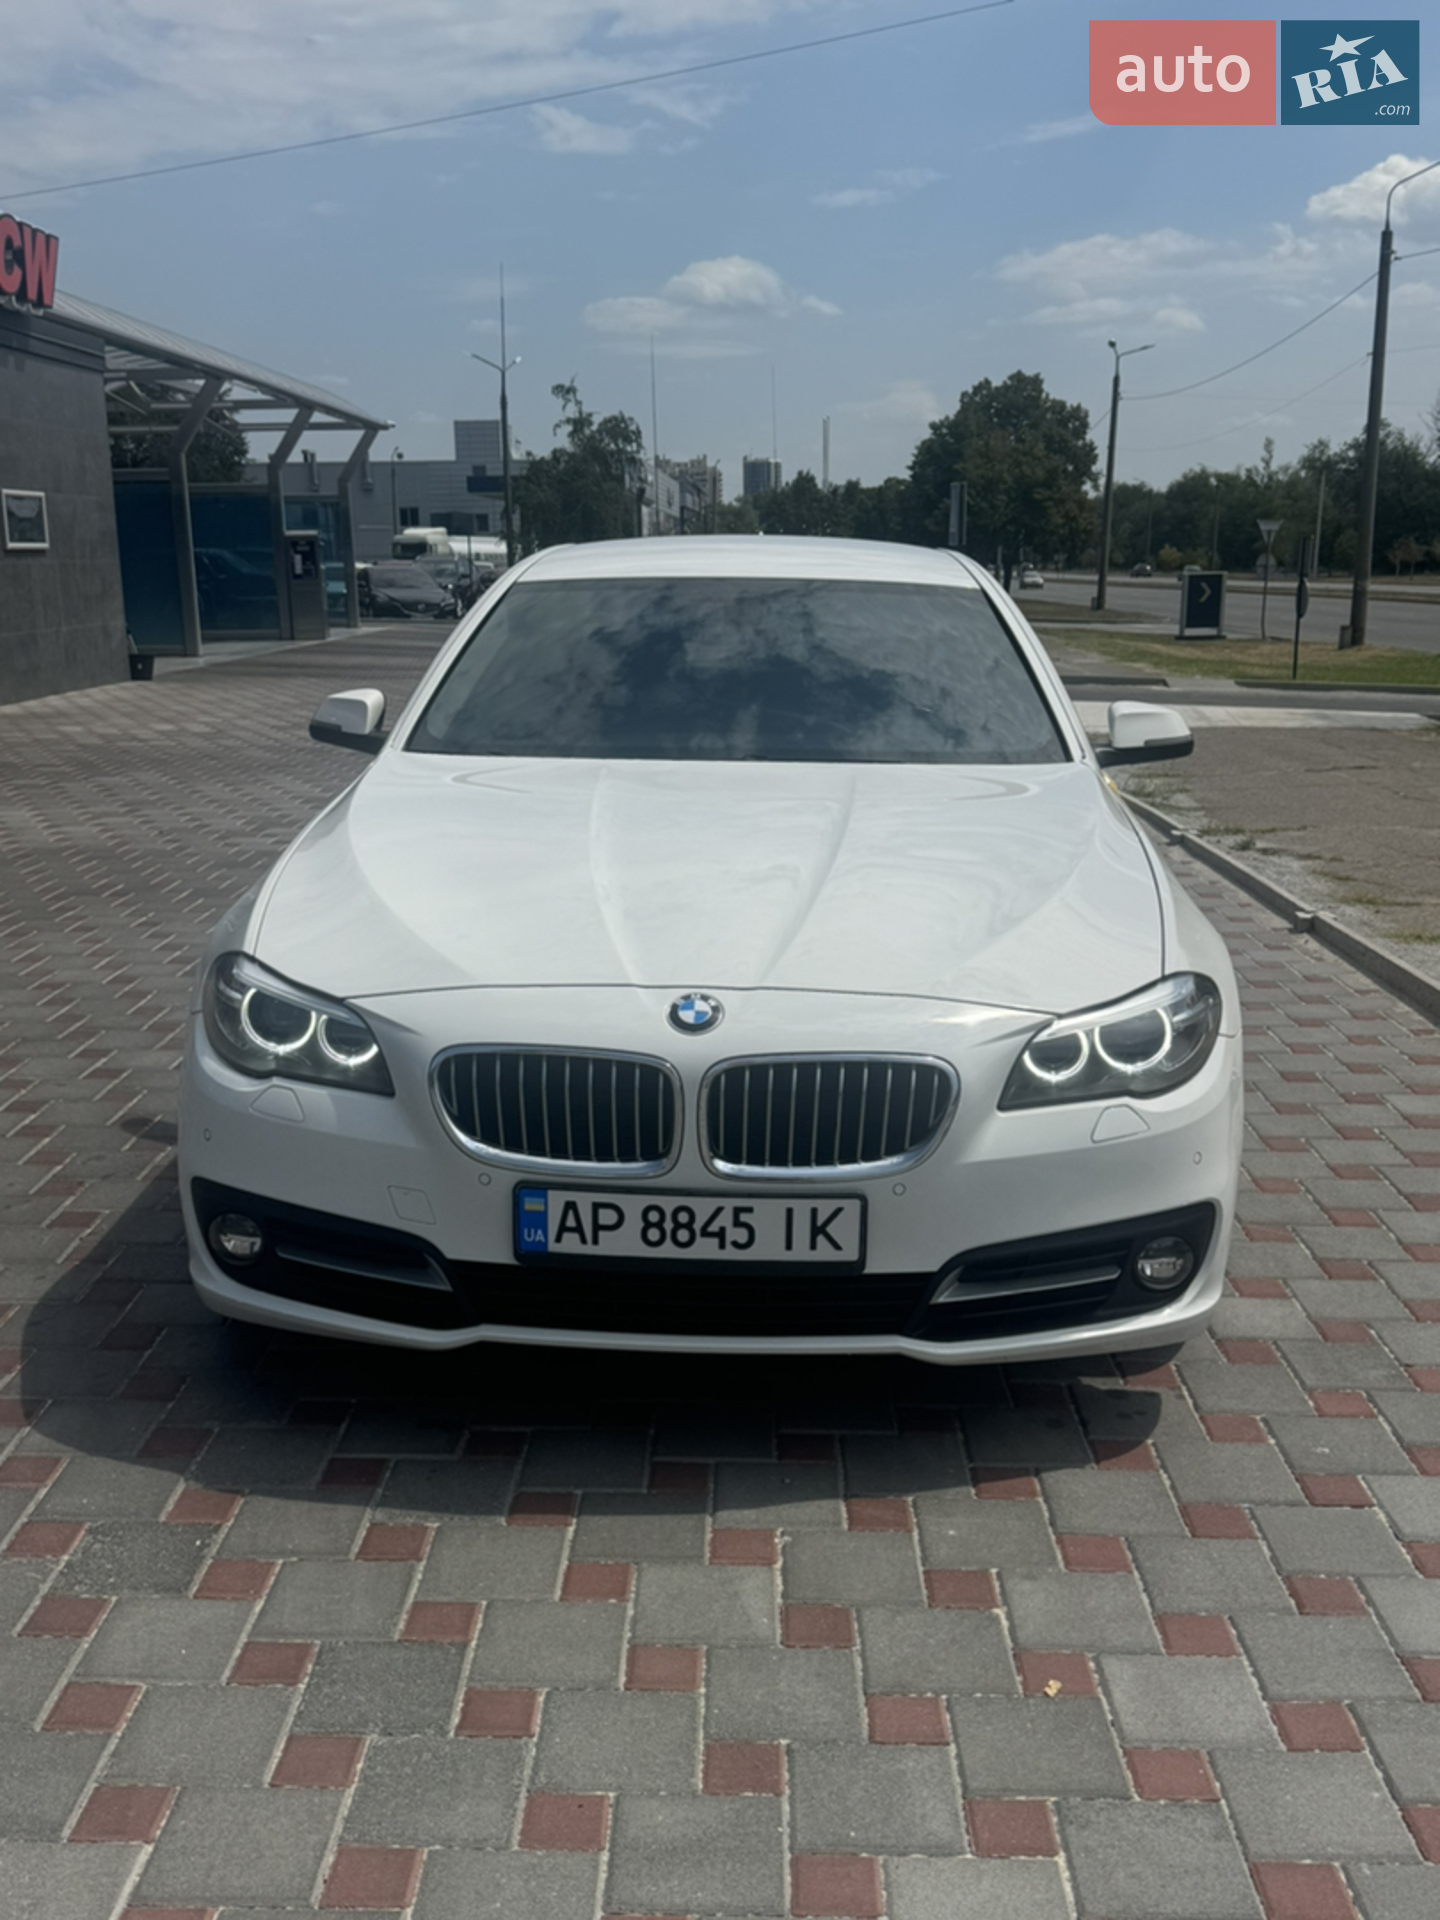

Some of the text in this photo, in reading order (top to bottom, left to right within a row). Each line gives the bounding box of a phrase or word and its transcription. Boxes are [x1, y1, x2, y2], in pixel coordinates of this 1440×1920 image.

[523, 1228, 546, 1243] UA
[554, 1200, 845, 1252] AP 8845 IK
